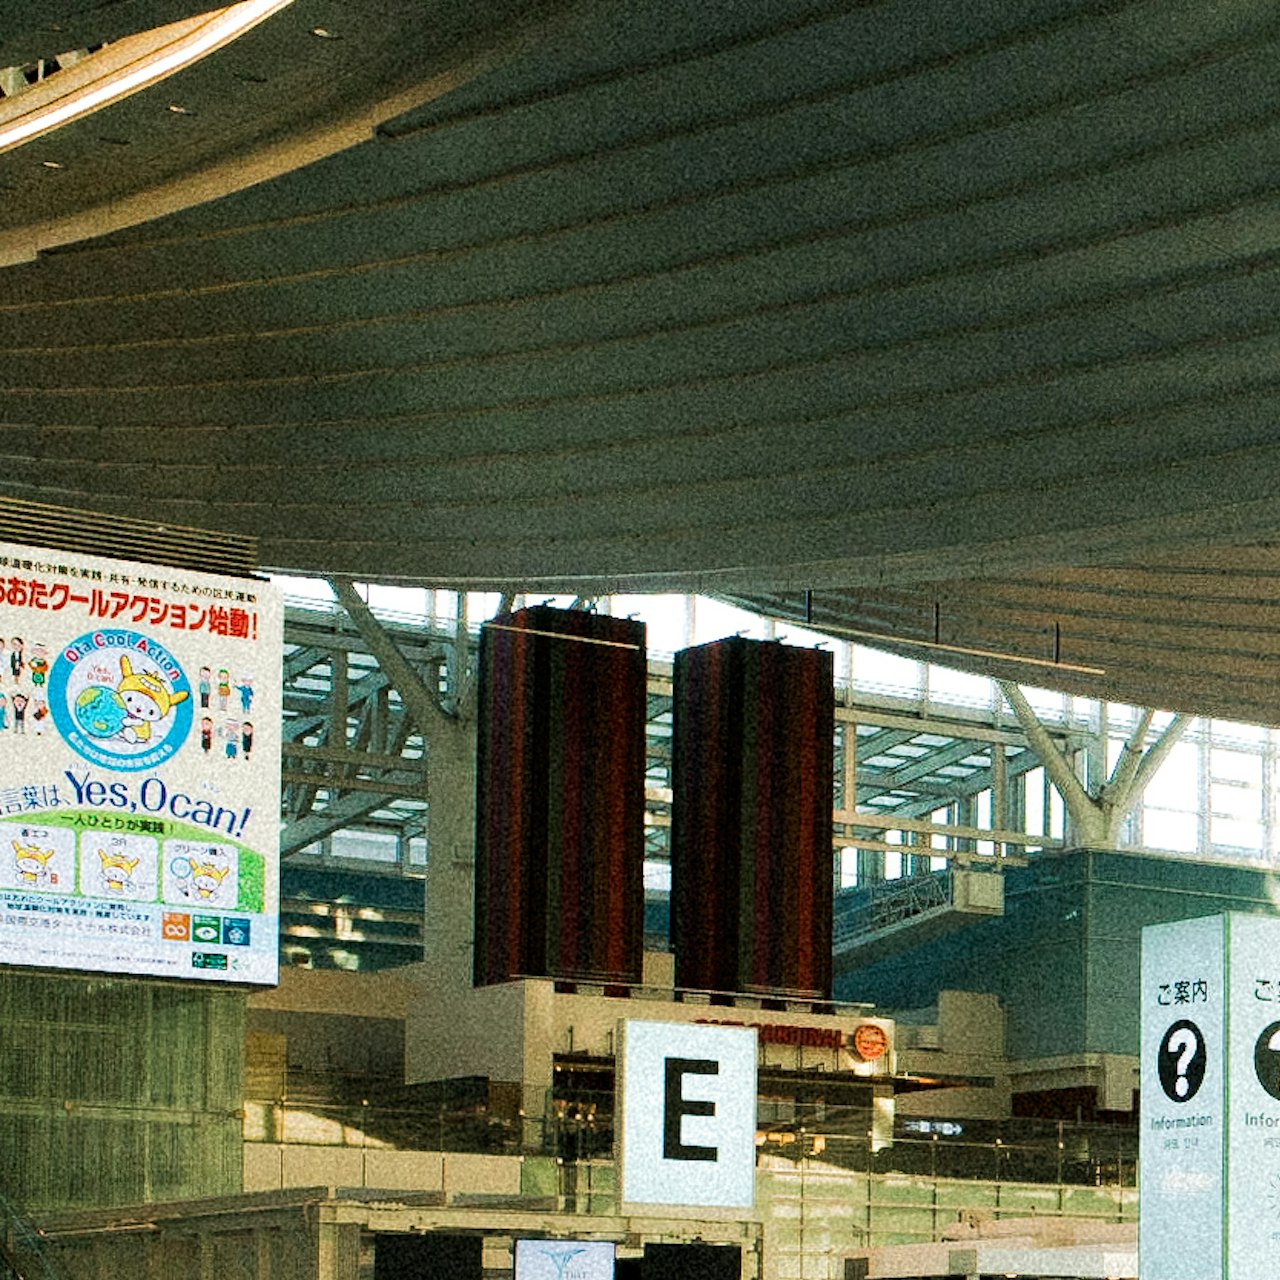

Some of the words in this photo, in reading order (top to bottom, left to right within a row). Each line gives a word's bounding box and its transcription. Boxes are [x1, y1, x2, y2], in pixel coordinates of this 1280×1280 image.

[1157, 979, 1209, 1007] ご案内
[663, 1057, 719, 1162] E
[1151, 1112, 1214, 1132] Information
